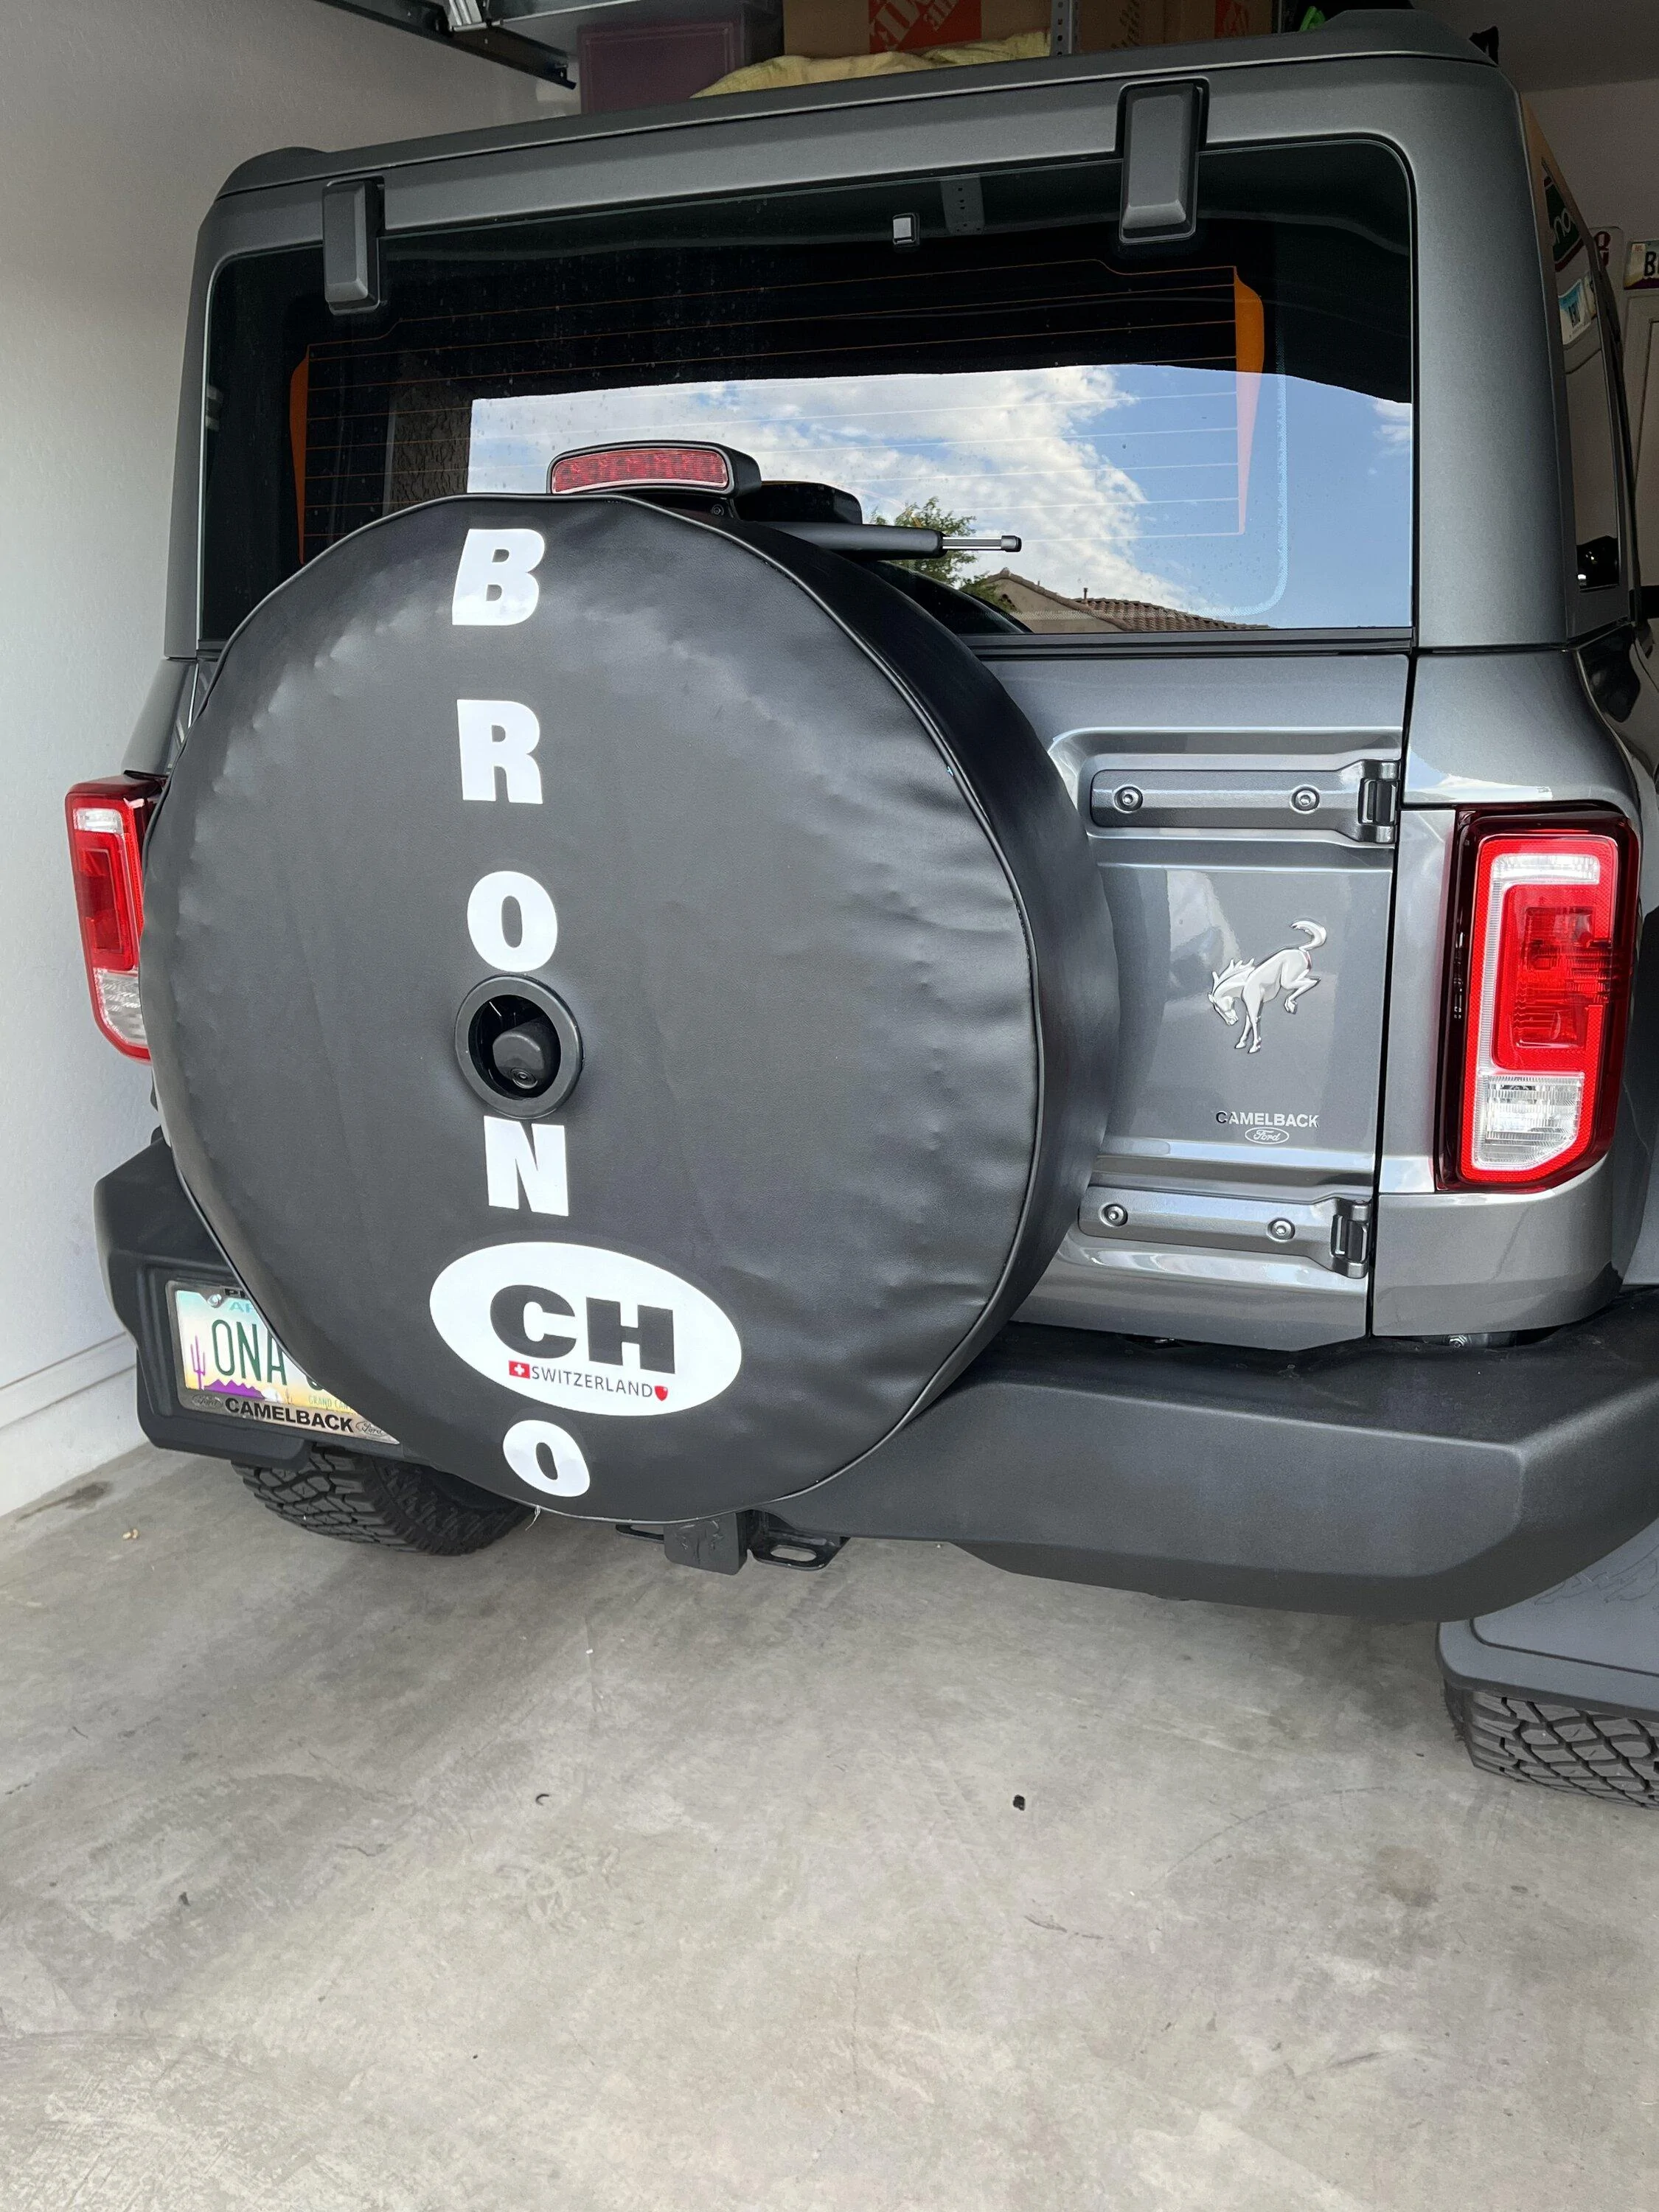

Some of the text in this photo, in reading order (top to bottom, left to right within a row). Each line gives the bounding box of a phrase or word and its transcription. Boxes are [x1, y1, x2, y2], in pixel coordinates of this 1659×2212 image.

[452, 529, 590, 1497] BRONO
[1216, 1111, 1319, 1127] CAMELBACK
[1251, 1128, 1284, 1143] Ford
[490, 1284, 675, 1374] CH
[532, 1366, 653, 1397] SWITZERLAND
[225, 1397, 354, 1433] CAMELBACK
